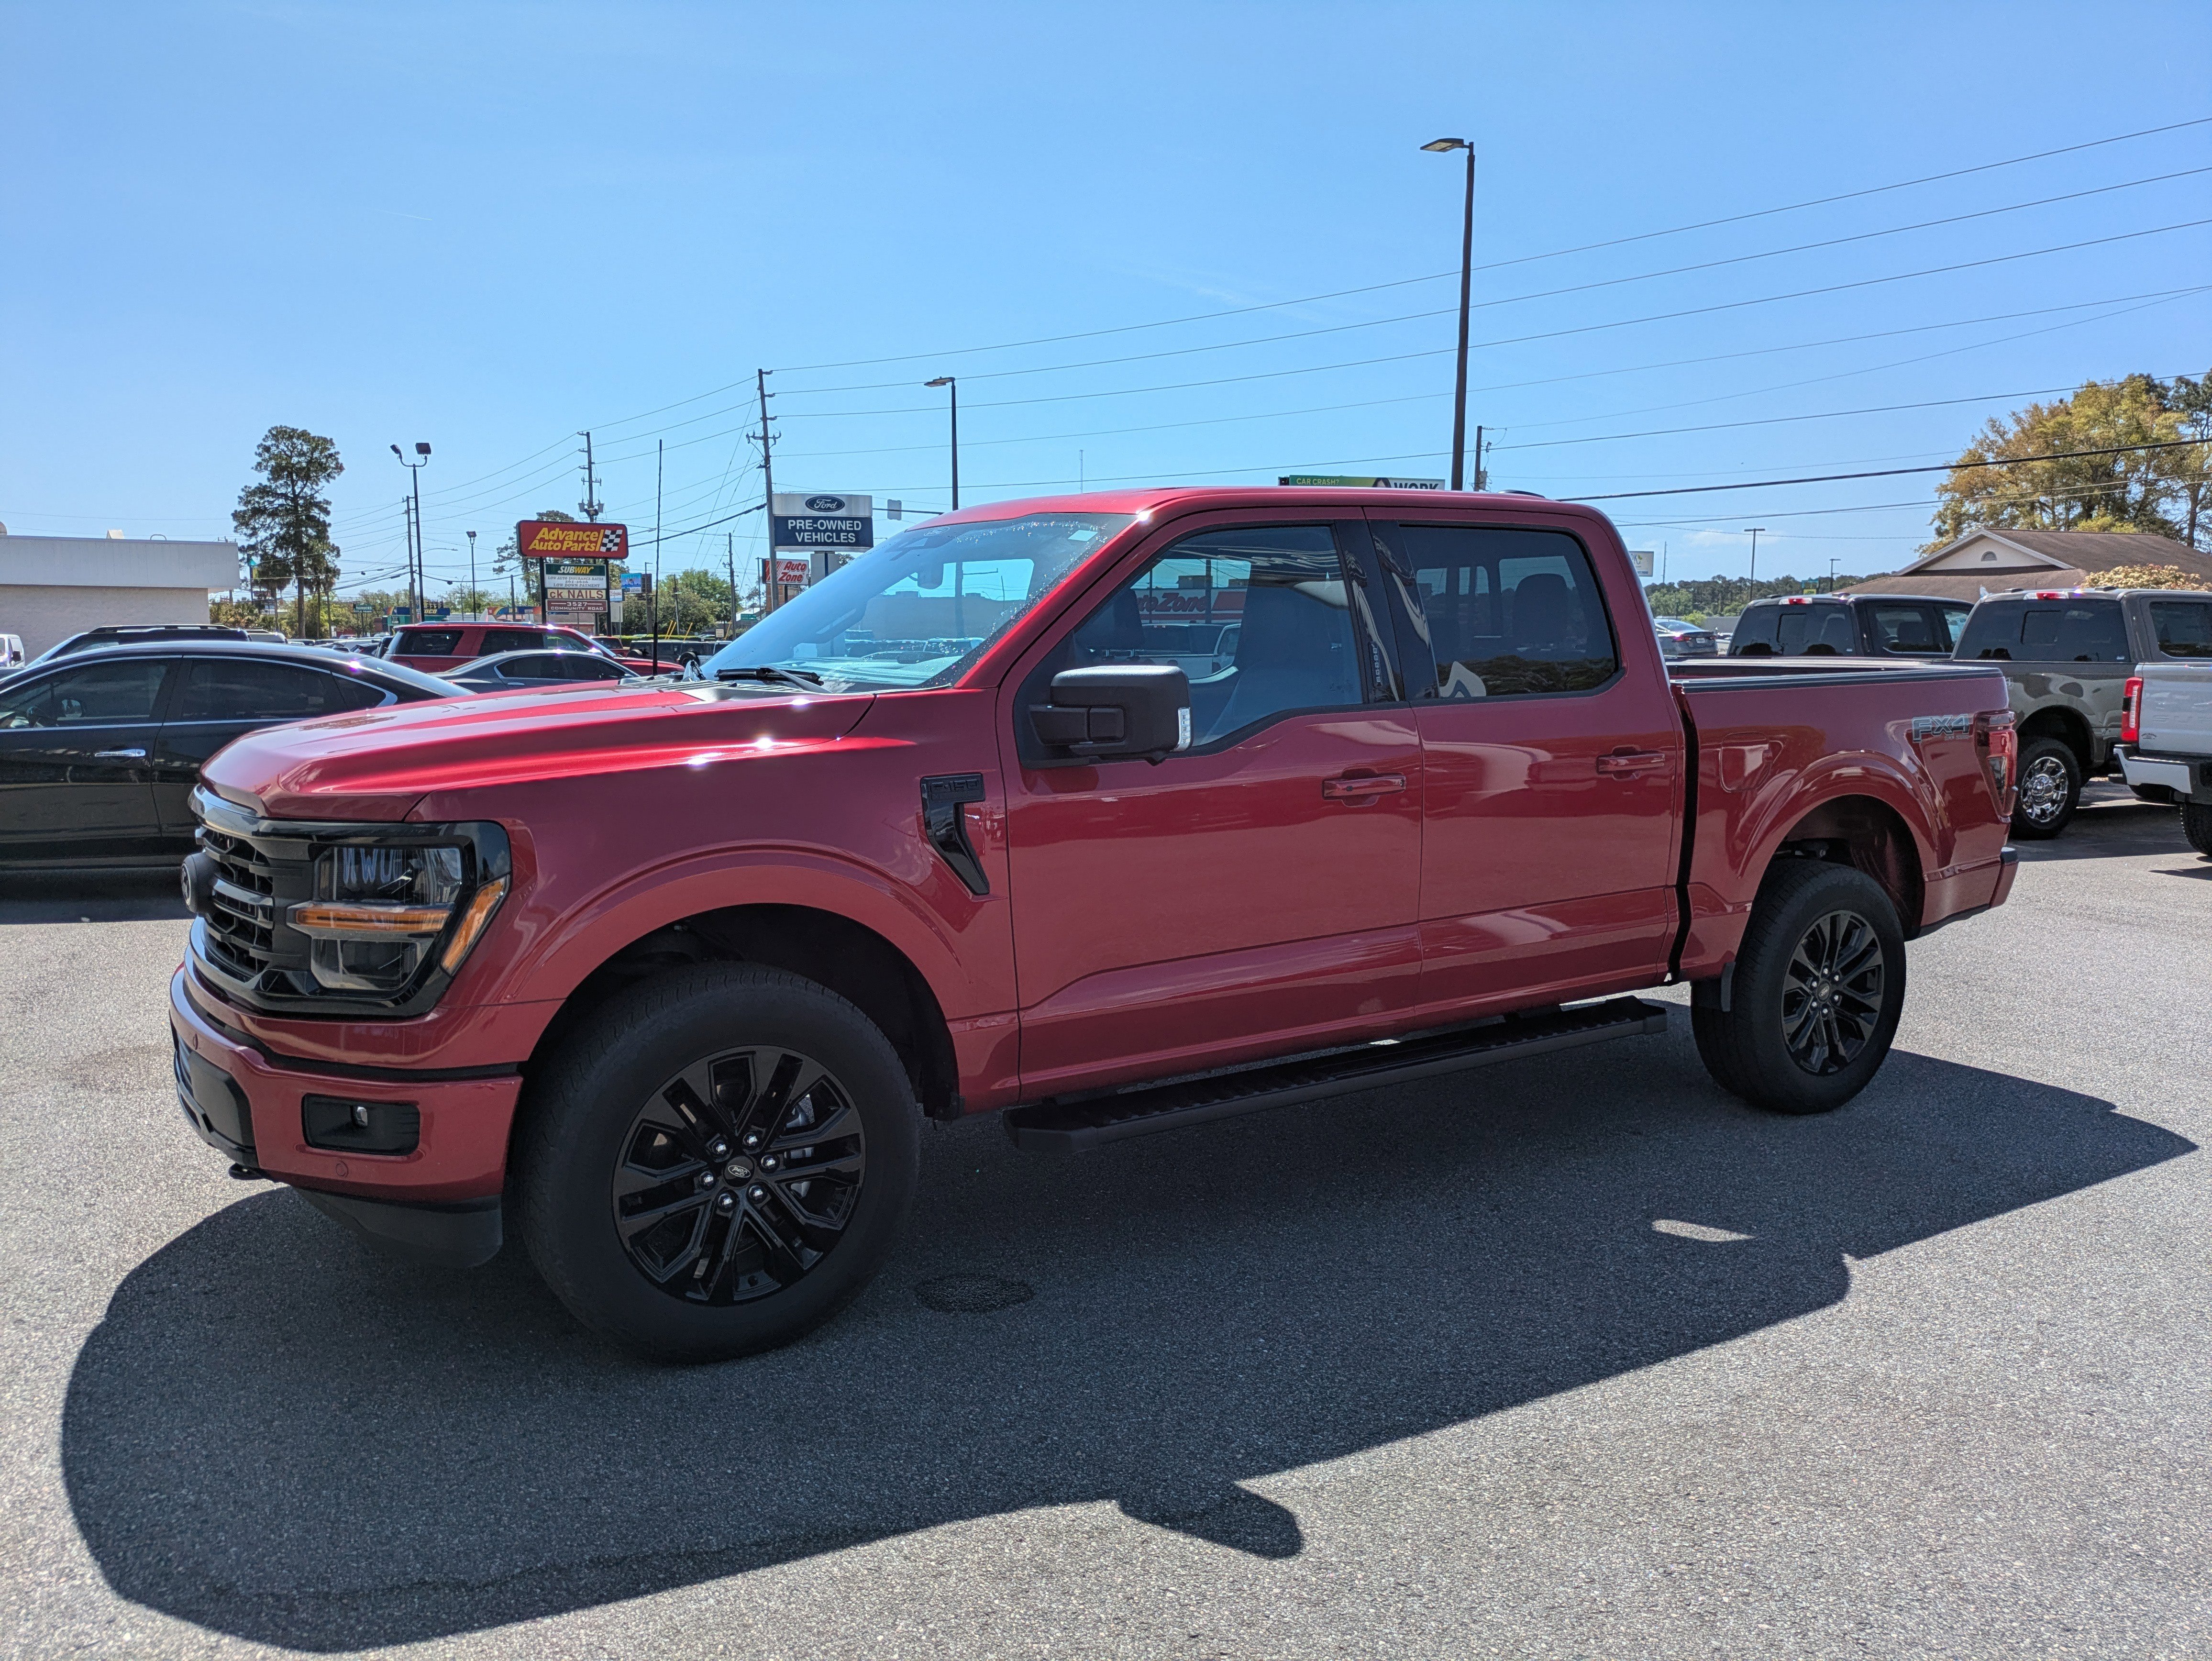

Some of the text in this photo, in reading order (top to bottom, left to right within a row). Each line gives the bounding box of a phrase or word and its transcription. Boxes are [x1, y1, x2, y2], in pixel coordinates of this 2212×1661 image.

[814, 498, 838, 509] Ford
[787, 520, 862, 531] PRE-OWNED
[535, 527, 598, 541] Advance
[795, 532, 856, 543] VEHICLES
[528, 539, 597, 552] Auto Parts
[557, 565, 594, 574] SUBWAY
[783, 561, 807, 572] Auto
[778, 572, 804, 583] Zone
[567, 590, 603, 599] NAILS
[1912, 713, 1969, 743] FX4
